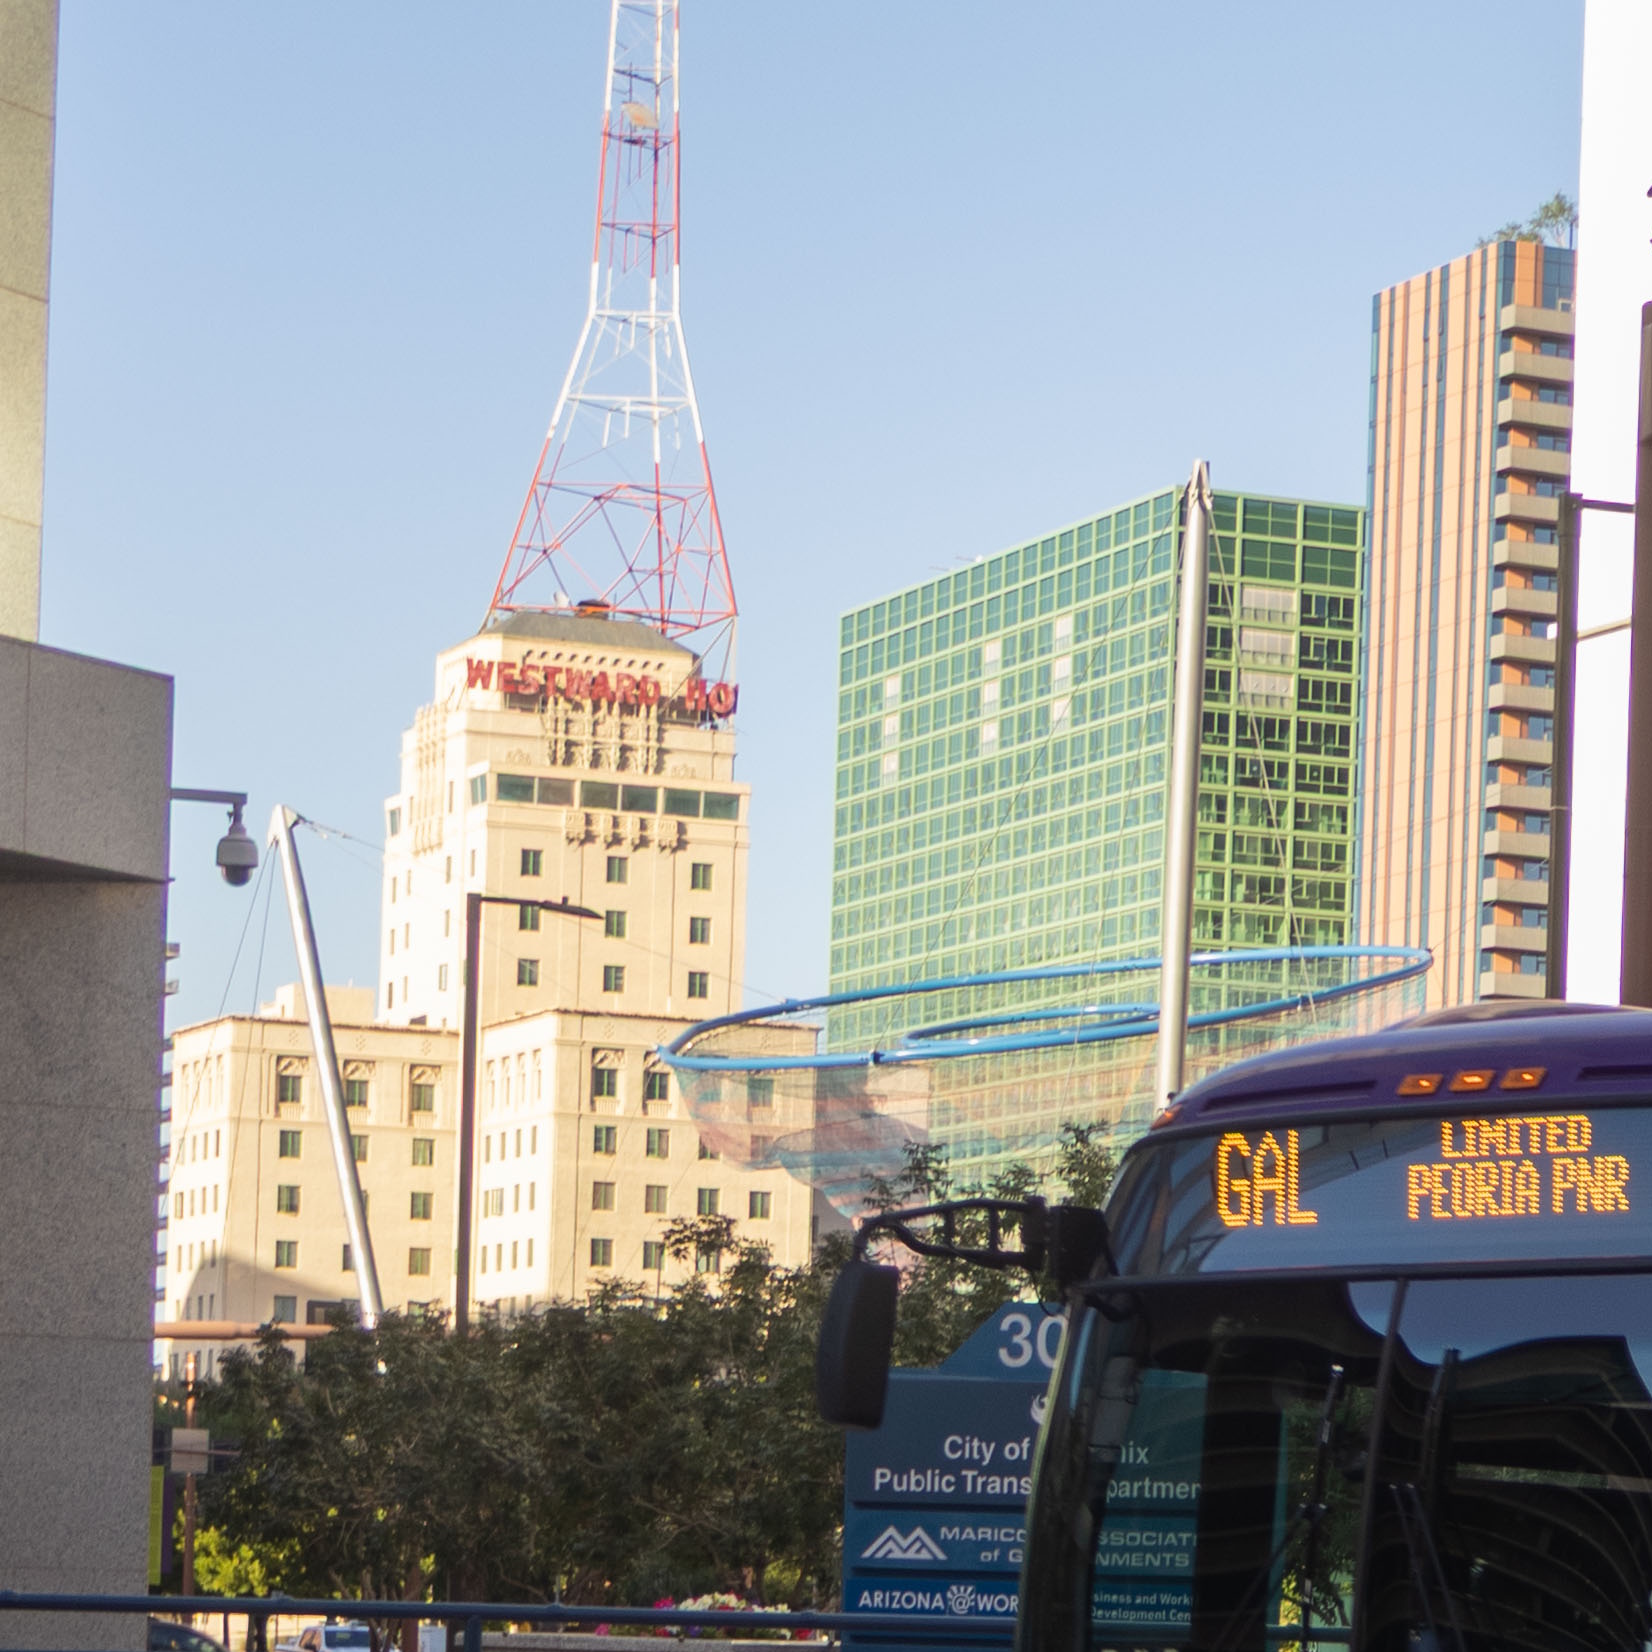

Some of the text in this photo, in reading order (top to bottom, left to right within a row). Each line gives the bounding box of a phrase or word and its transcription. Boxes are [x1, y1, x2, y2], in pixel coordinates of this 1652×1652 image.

[466, 657, 737, 718] WESTWARD HO
[1441, 1114, 1592, 1158] LIMITED
[1217, 1128, 1318, 1228] GAL
[1407, 1159, 1540, 1220] PEORIA
[944, 1434, 996, 1466] City
[1004, 1437, 1031, 1460] of
[874, 1467, 956, 1492] Public
[980, 1548, 1000, 1562] of
[1135, 1593, 1157, 1606] and
[1159, 1593, 1192, 1607] Work
